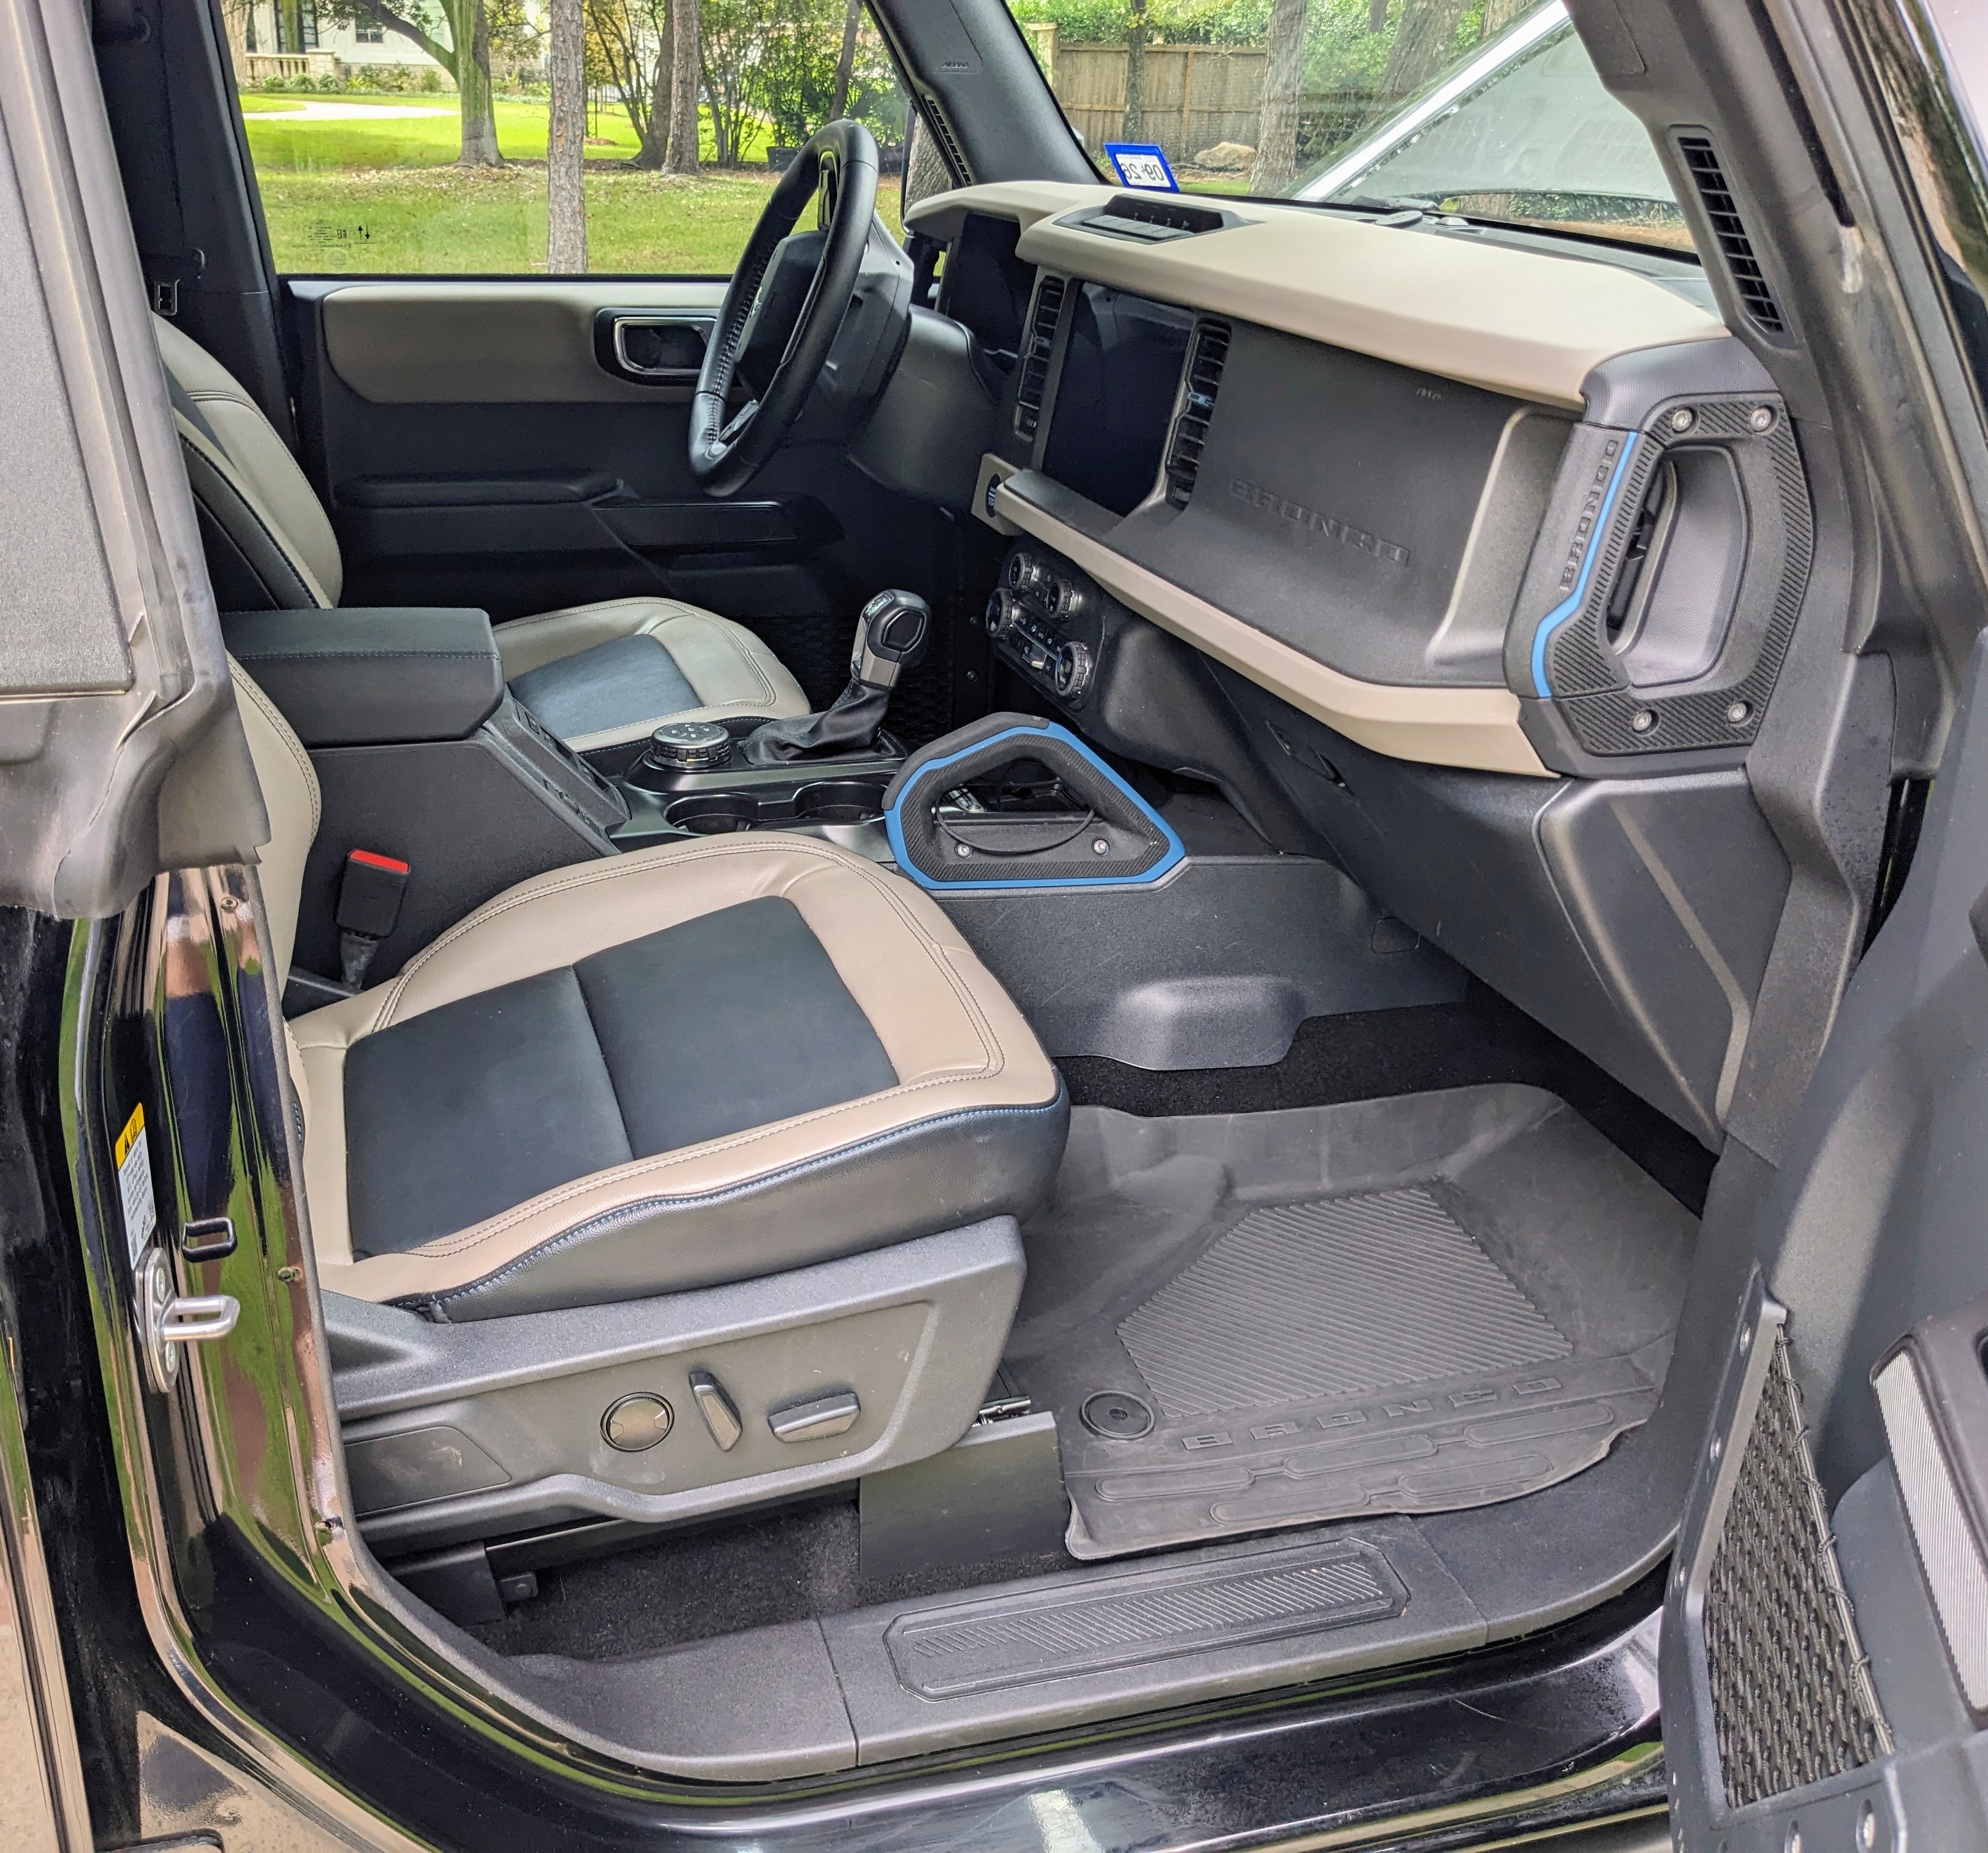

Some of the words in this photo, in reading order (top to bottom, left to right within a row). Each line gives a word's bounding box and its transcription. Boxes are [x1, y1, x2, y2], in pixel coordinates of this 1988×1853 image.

[1230, 477, 1411, 567] BRONCO
[1559, 439, 1619, 590] BRONCO
[1181, 1377, 1562, 1450] BRONCO
